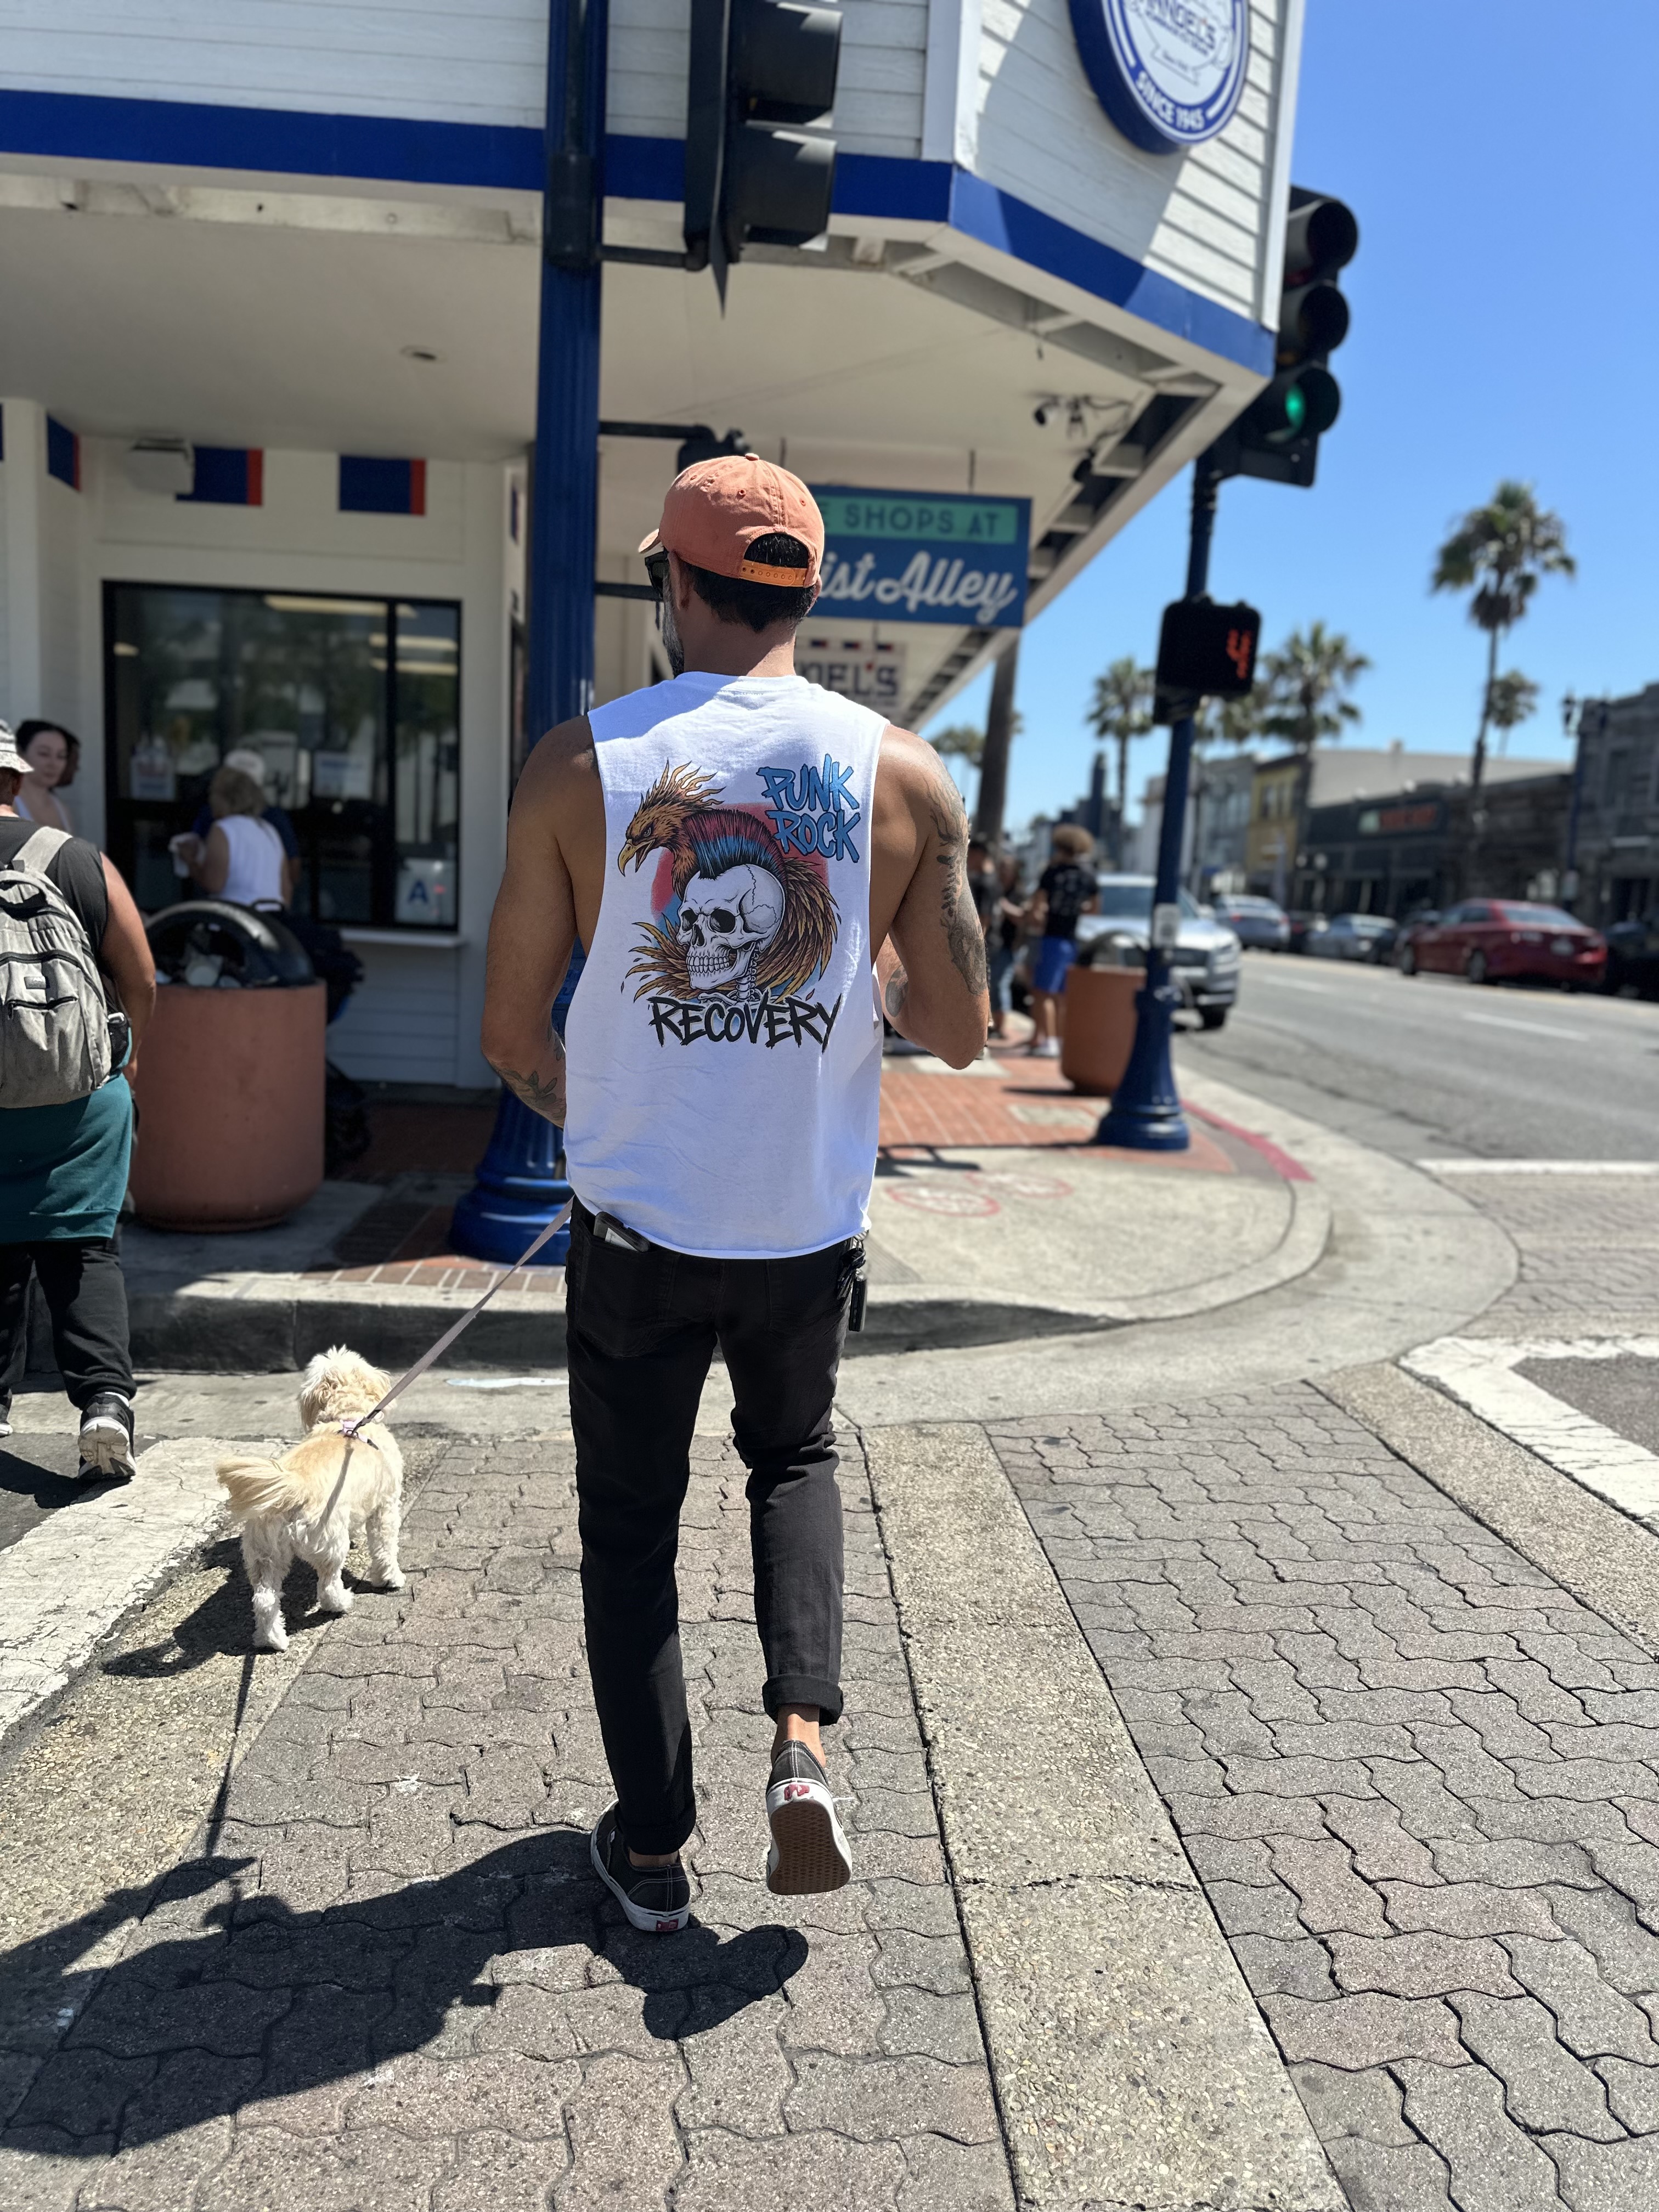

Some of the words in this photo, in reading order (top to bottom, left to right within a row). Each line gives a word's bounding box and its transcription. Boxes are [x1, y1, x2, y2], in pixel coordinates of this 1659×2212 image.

[844, 501, 955, 534] SHOPS
[968, 511, 1002, 537] AT
[820, 551, 877, 601] ist
[874, 550, 1018, 624] Alley
[1226, 629, 1252, 679] 4
[756, 753, 860, 811] PUNK
[765, 809, 860, 862] ROCK
[407, 878, 429, 905] A
[646, 989, 843, 1053] RECOVERY
